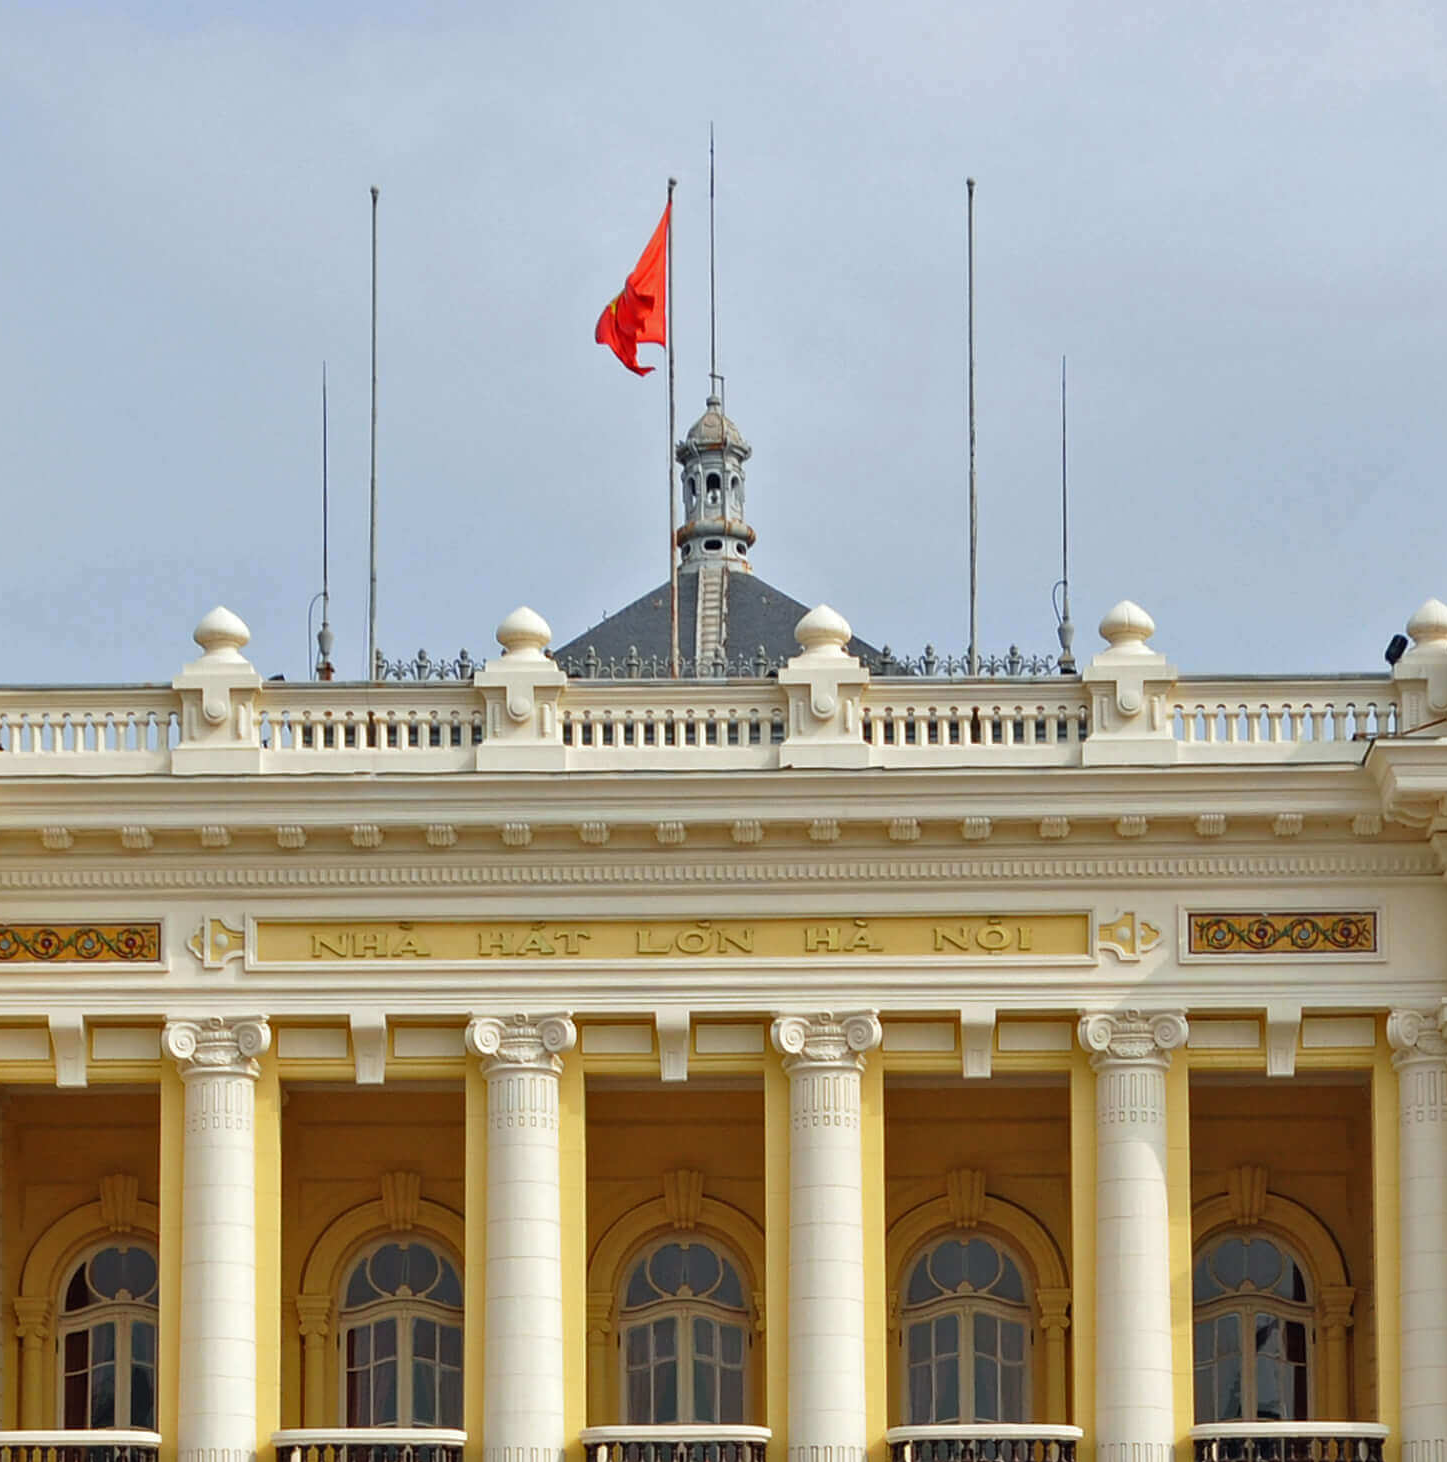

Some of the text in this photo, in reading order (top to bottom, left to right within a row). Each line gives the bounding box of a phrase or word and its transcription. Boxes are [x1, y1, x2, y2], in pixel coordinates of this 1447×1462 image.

[311, 917, 1032, 958] NHÀ HÁT LỚN HÀ NỘI
